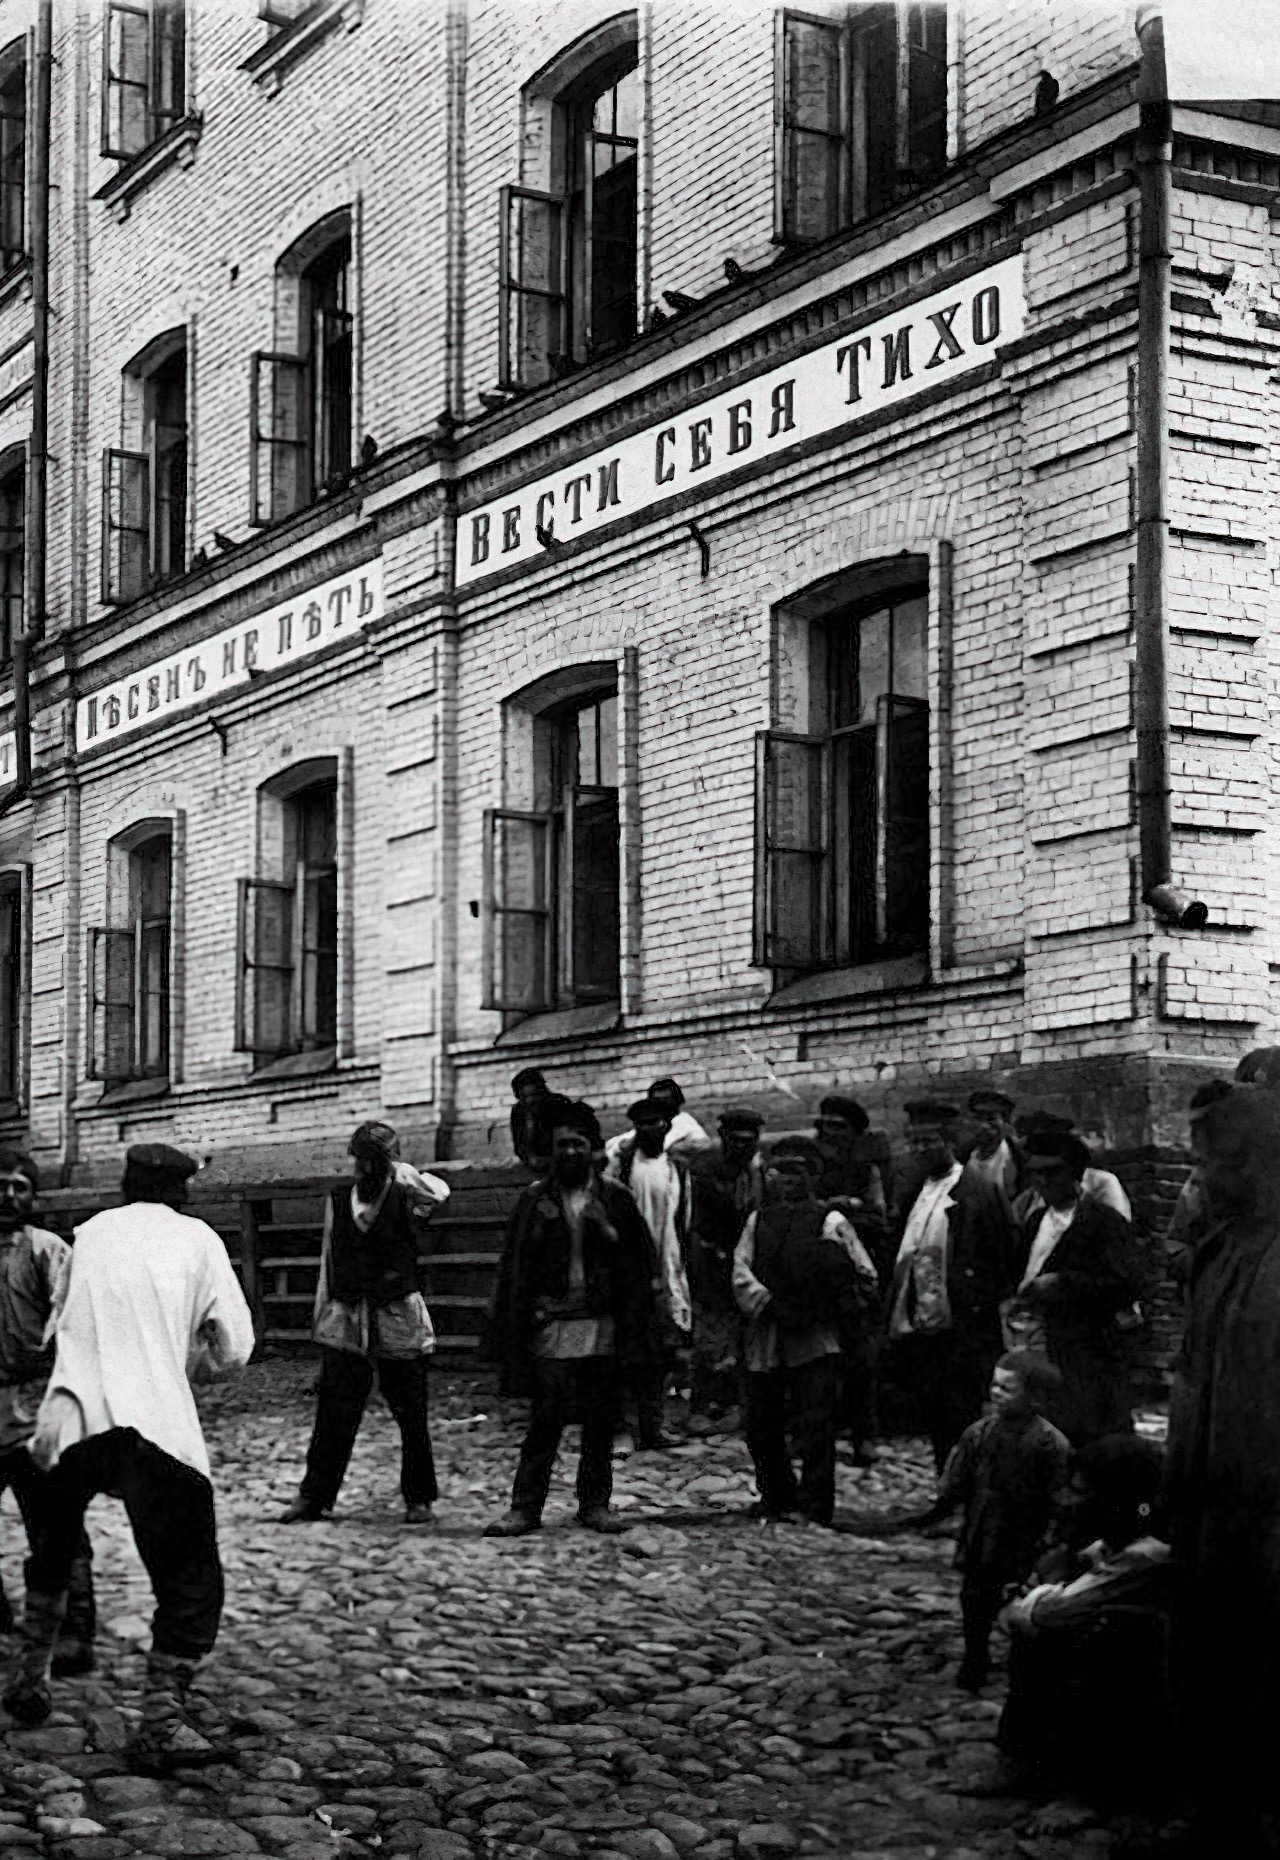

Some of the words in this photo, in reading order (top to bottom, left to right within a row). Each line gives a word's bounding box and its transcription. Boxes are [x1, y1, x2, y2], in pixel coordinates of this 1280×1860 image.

[470, 457, 622, 566] ВЕСТИ
[654, 378, 796, 486] СЕБЯ
[836, 285, 1001, 405] ТИХО
[86, 654, 207, 740] ПѢСЕНЪ
[221, 628, 259, 679] НЕ
[276, 576, 375, 655] ПѢТЬ
